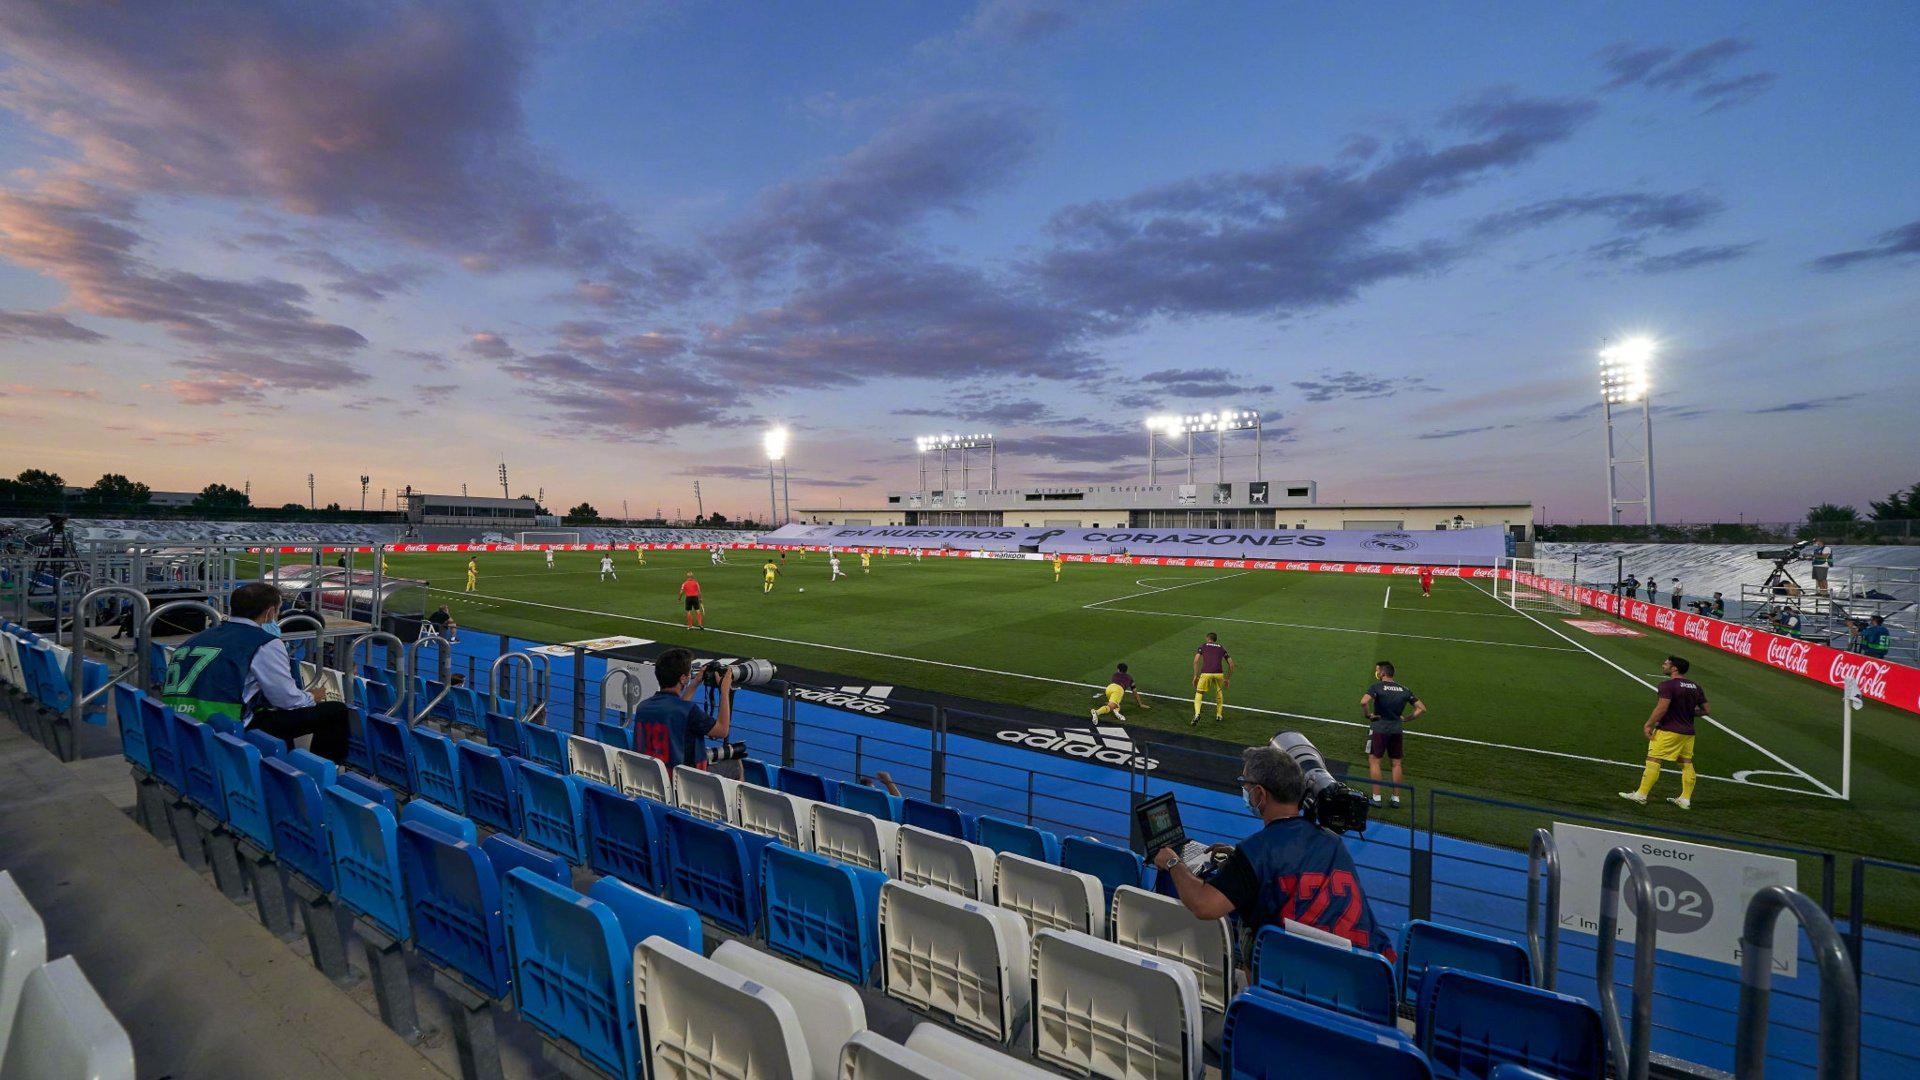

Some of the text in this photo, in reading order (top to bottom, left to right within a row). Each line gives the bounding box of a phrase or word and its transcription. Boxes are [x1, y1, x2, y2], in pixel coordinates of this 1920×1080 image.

[834, 529, 1327, 547] EN NUESTROS CORAZONES
[1654, 609, 1676, 632] Coca-Cola
[1684, 616, 1710, 642] Coca-Cola
[1720, 625, 1754, 657] Coca-Cola
[162, 645, 222, 695] 67
[1767, 637, 1811, 675] Coca-Cola
[623, 683, 640, 697] 13
[1830, 653, 1891, 699] Coca-Cola
[996, 730, 1160, 770] adidas
[1641, 843, 1695, 862] Sector
[1653, 885, 1703, 918] 02
[1579, 917, 1624, 936] Imr
